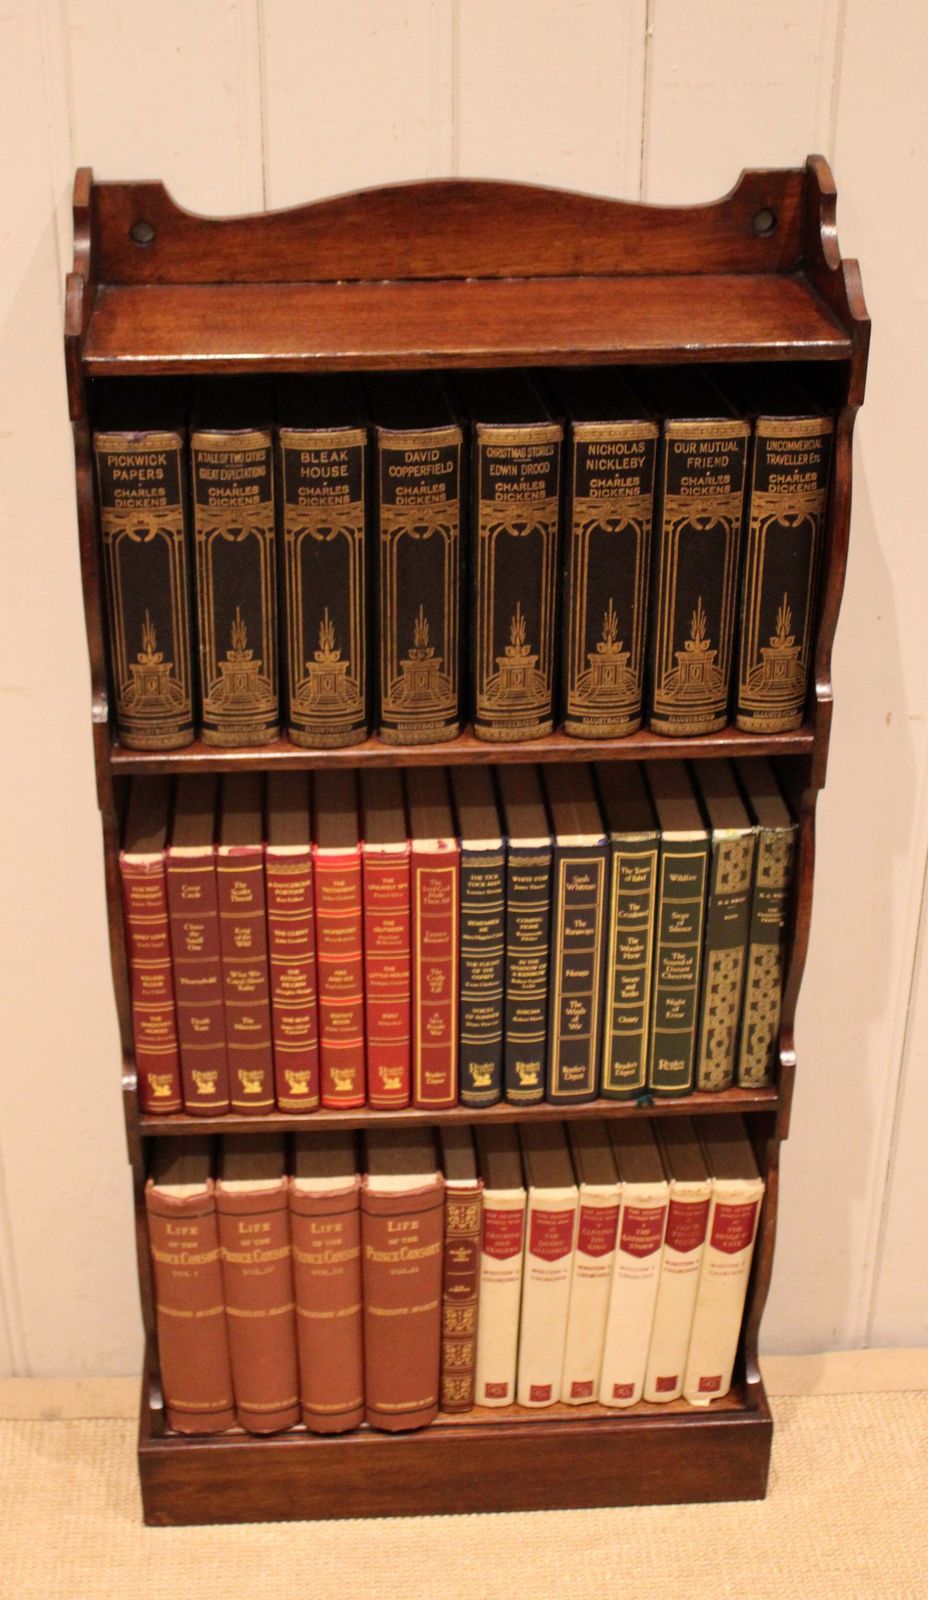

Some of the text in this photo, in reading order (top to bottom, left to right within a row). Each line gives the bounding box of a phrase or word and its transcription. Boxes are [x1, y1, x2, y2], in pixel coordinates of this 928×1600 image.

[588, 442, 645, 455] NICHOLAS
[674, 441, 739, 453] OUR MUTUAL
[767, 439, 822, 451] UNCOMMERCIAL
[202, 453, 220, 464] TALE
[220, 452, 229, 464] OF
[229, 451, 244, 463] TWO
[244, 450, 266, 461] CITIES
[300, 451, 348, 463] BLEAK
[405, 450, 440, 462] DAVID
[487, 445, 554, 458] CHRISTMAS STORIES
[108, 454, 167, 466] PICKWICK
[586, 456, 646, 471] NICKLEBY
[687, 456, 729, 468] FRIEND
[766, 454, 808, 465] TRAVELLER
[200, 466, 266, 480] GREAT EXPECTATIONS
[301, 465, 348, 478] HOUSE
[389, 462, 453, 478] COPPERFIELD
[490, 461, 550, 476] EDWIN DROOD
[113, 469, 164, 480] PAPERS
[769, 472, 817, 483] CHARLES
[495, 481, 545, 491] CHARLES
[590, 477, 640, 488] CHARLES
[681, 475, 731, 486] CHARLES
[114, 488, 165, 497] CHARLES
[208, 486, 259, 496] CHARLES
[298, 485, 349, 495] CHARLES
[395, 484, 446, 495] CHARLES
[590, 487, 640, 498] DICKENS
[680, 485, 730, 496] DICKENS
[768, 482, 817, 493] DICKENS
[208, 496, 260, 506] DICKENS
[298, 495, 350, 505] DICKENS
[396, 493, 446, 505] DICKENS
[495, 490, 546, 501] DICKENS
[114, 498, 167, 508] DICKENS
[621, 866, 633, 874] The
[625, 874, 632, 882] of
[686, 957, 693, 965] of
[166, 1224, 199, 1235] LIFE
[238, 1222, 271, 1233] LIFE
[311, 1223, 343, 1234] LIFE
[387, 1220, 419, 1232] LIFE
